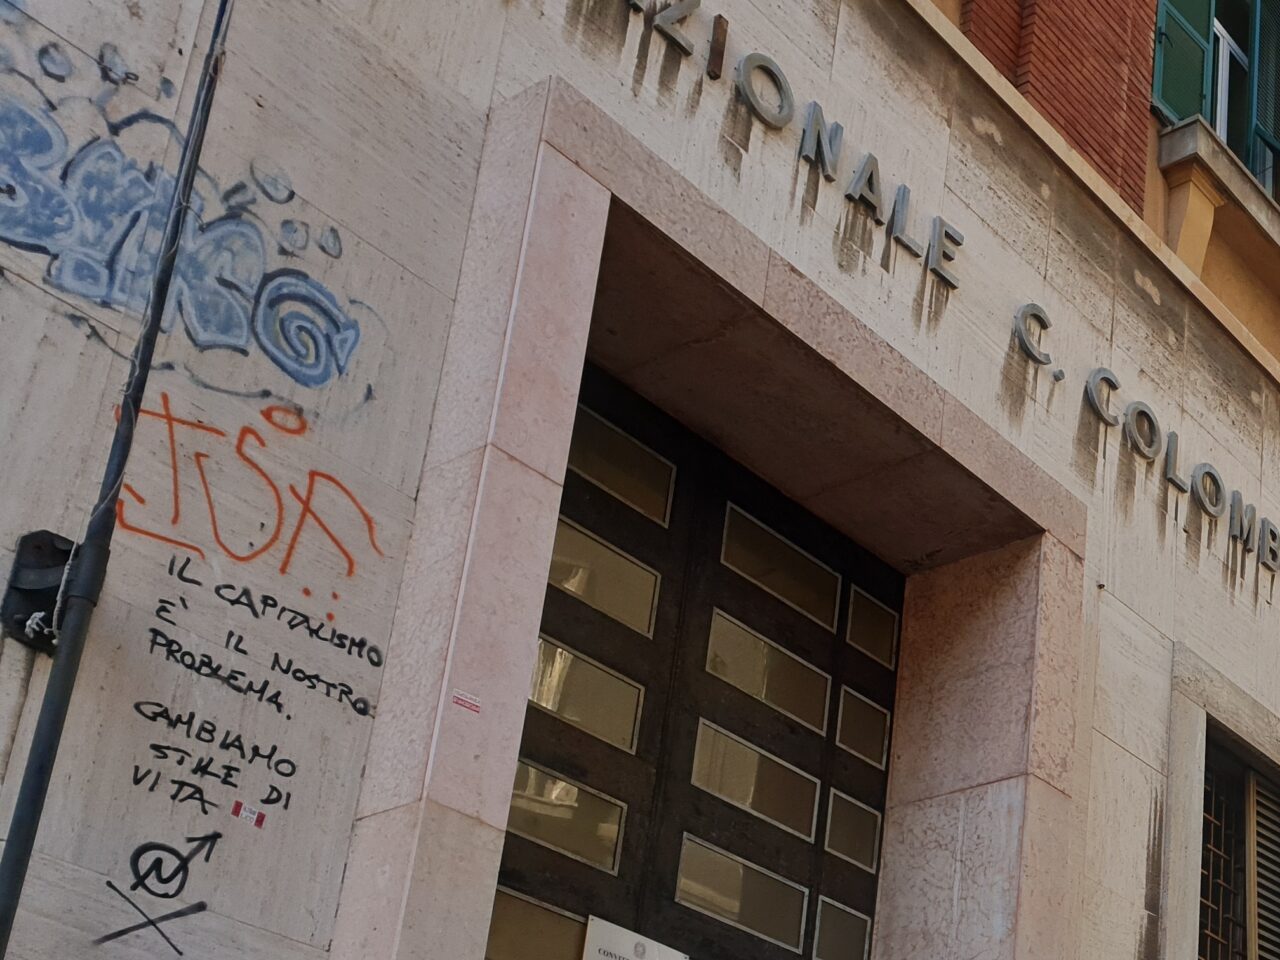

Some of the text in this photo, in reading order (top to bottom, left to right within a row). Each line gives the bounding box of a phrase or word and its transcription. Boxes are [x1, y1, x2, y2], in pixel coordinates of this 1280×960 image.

[627, 0, 965, 290] ZIONALE
[1014, 302, 1065, 382] C.
[168, 554, 383, 668] IL CAPITALISMO
[148, 627, 293, 721] PROBLEMA.
[225, 630, 248, 656] IL
[270, 652, 376, 717] NOSTRO
[133, 700, 297, 778] CAMBIAMO
[132, 764, 221, 816] VITA
[260, 784, 293, 811] DI
